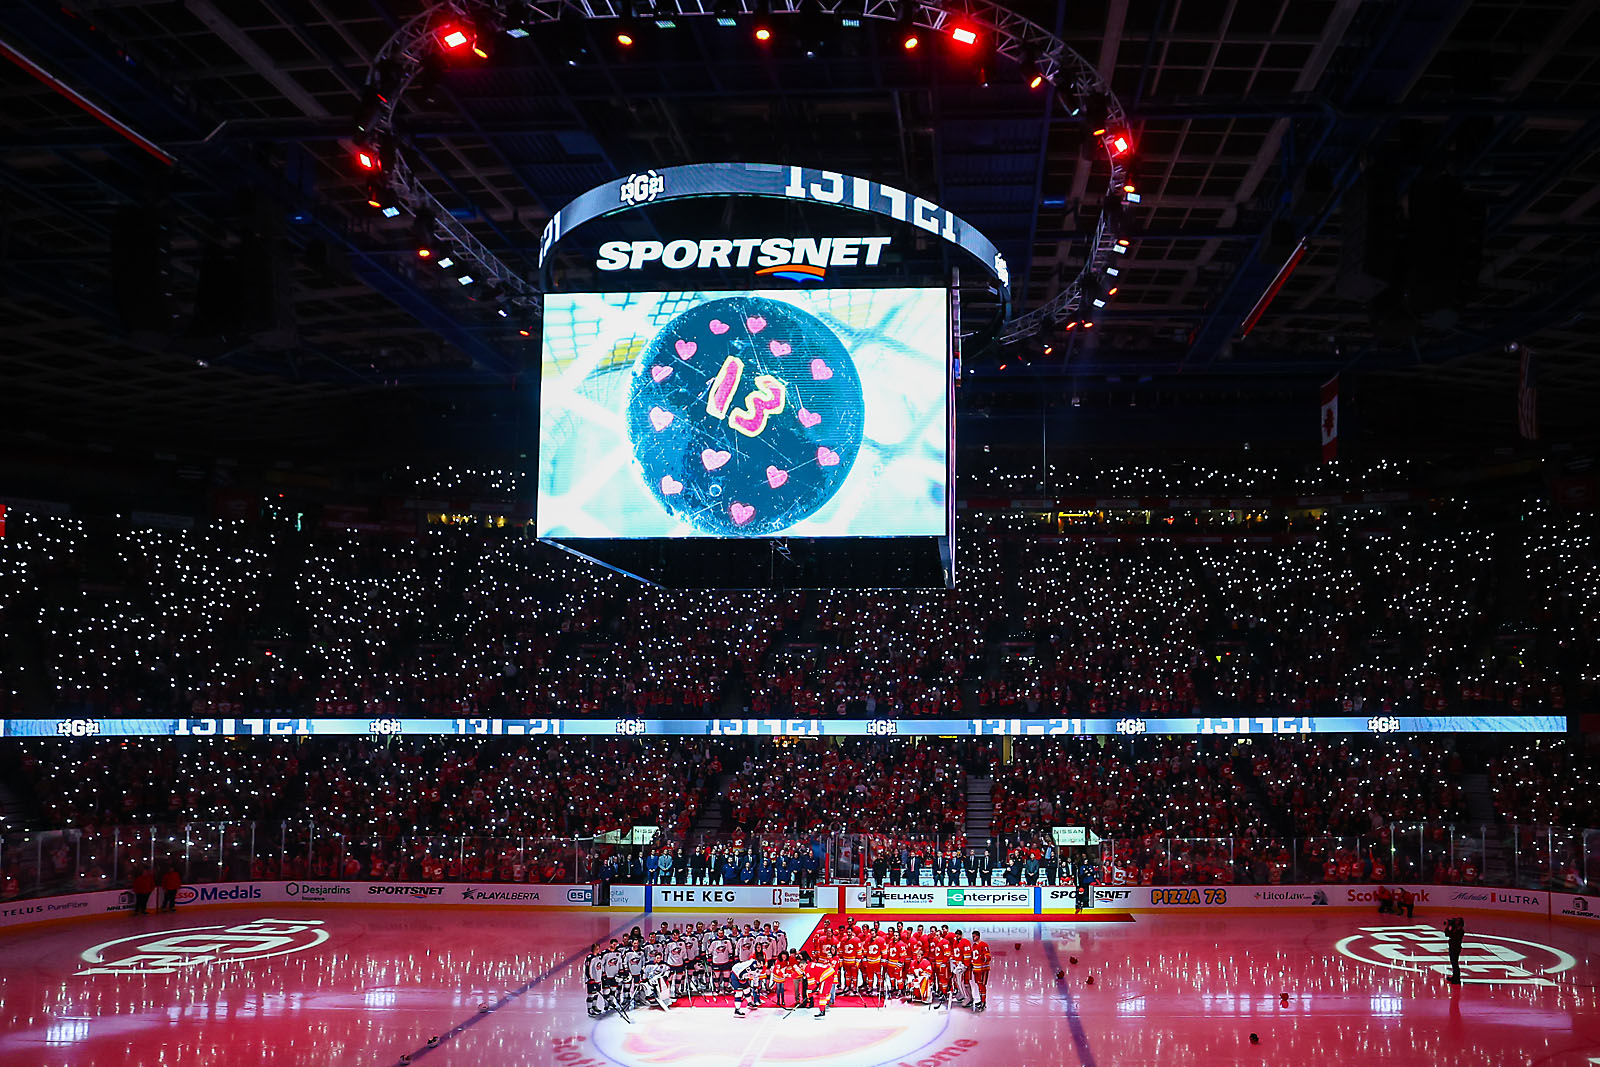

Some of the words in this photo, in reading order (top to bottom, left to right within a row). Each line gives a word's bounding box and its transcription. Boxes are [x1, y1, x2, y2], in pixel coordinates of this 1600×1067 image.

[596, 237, 892, 270] SPORTSNET
[200, 886, 261, 899] Medals
[302, 885, 351, 896] Desjardins
[368, 886, 444, 896] SPORTSNET
[661, 890, 695, 902] THE
[703, 890, 736, 902] KEG
[948, 892, 1027, 904] enterprise
[1151, 889, 1200, 905] PIZZA
[1203, 889, 1227, 905] 73
[1499, 894, 1540, 905] ULTRA
[3, 905, 44, 917] TELUS
